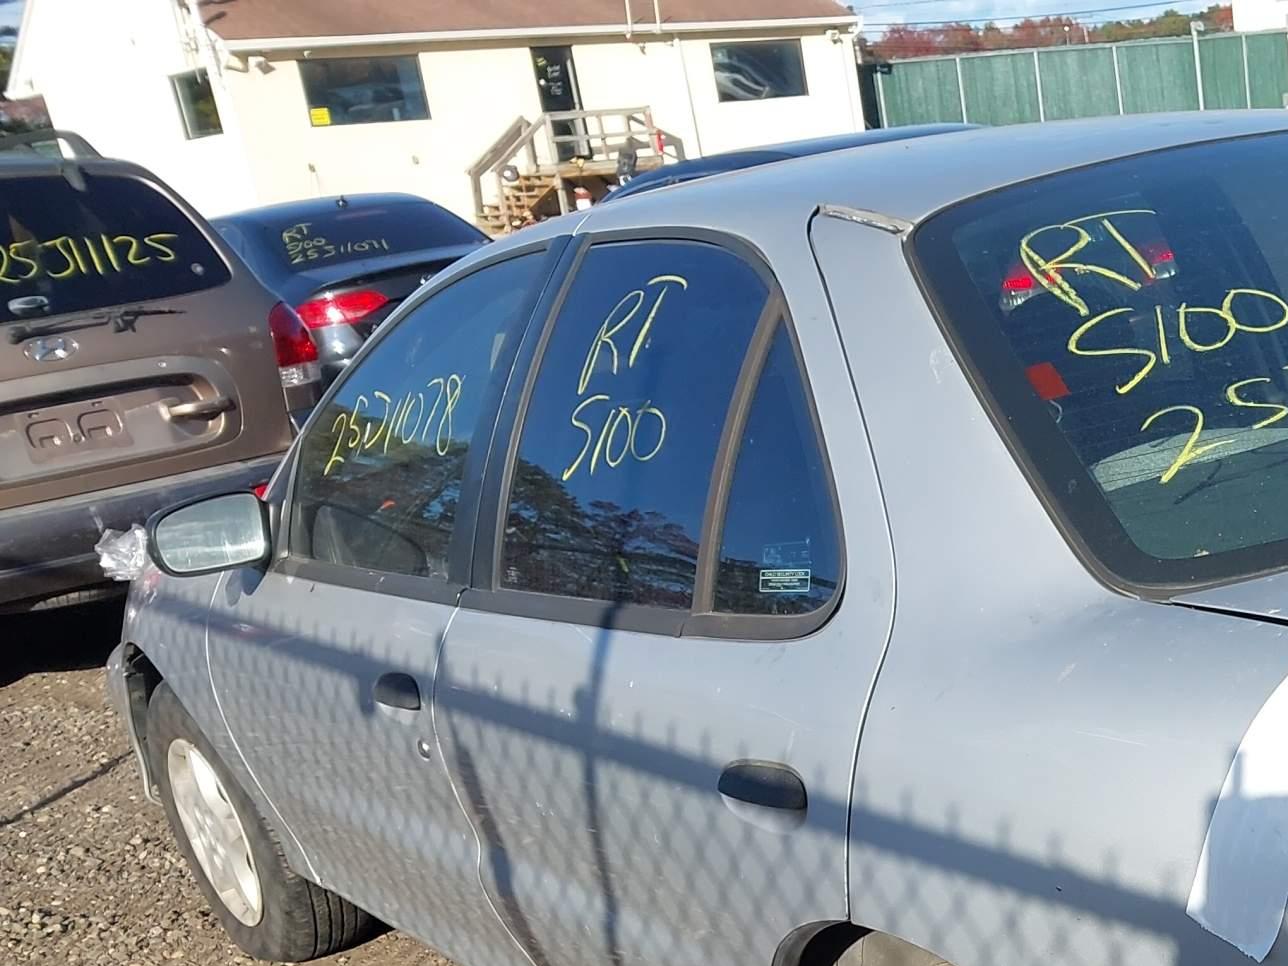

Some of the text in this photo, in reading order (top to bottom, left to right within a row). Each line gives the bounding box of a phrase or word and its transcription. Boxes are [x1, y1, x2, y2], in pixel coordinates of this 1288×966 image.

[282, 222, 312, 244] RT
[1018, 209, 1159, 317] RT
[577, 274, 688, 394] RT
